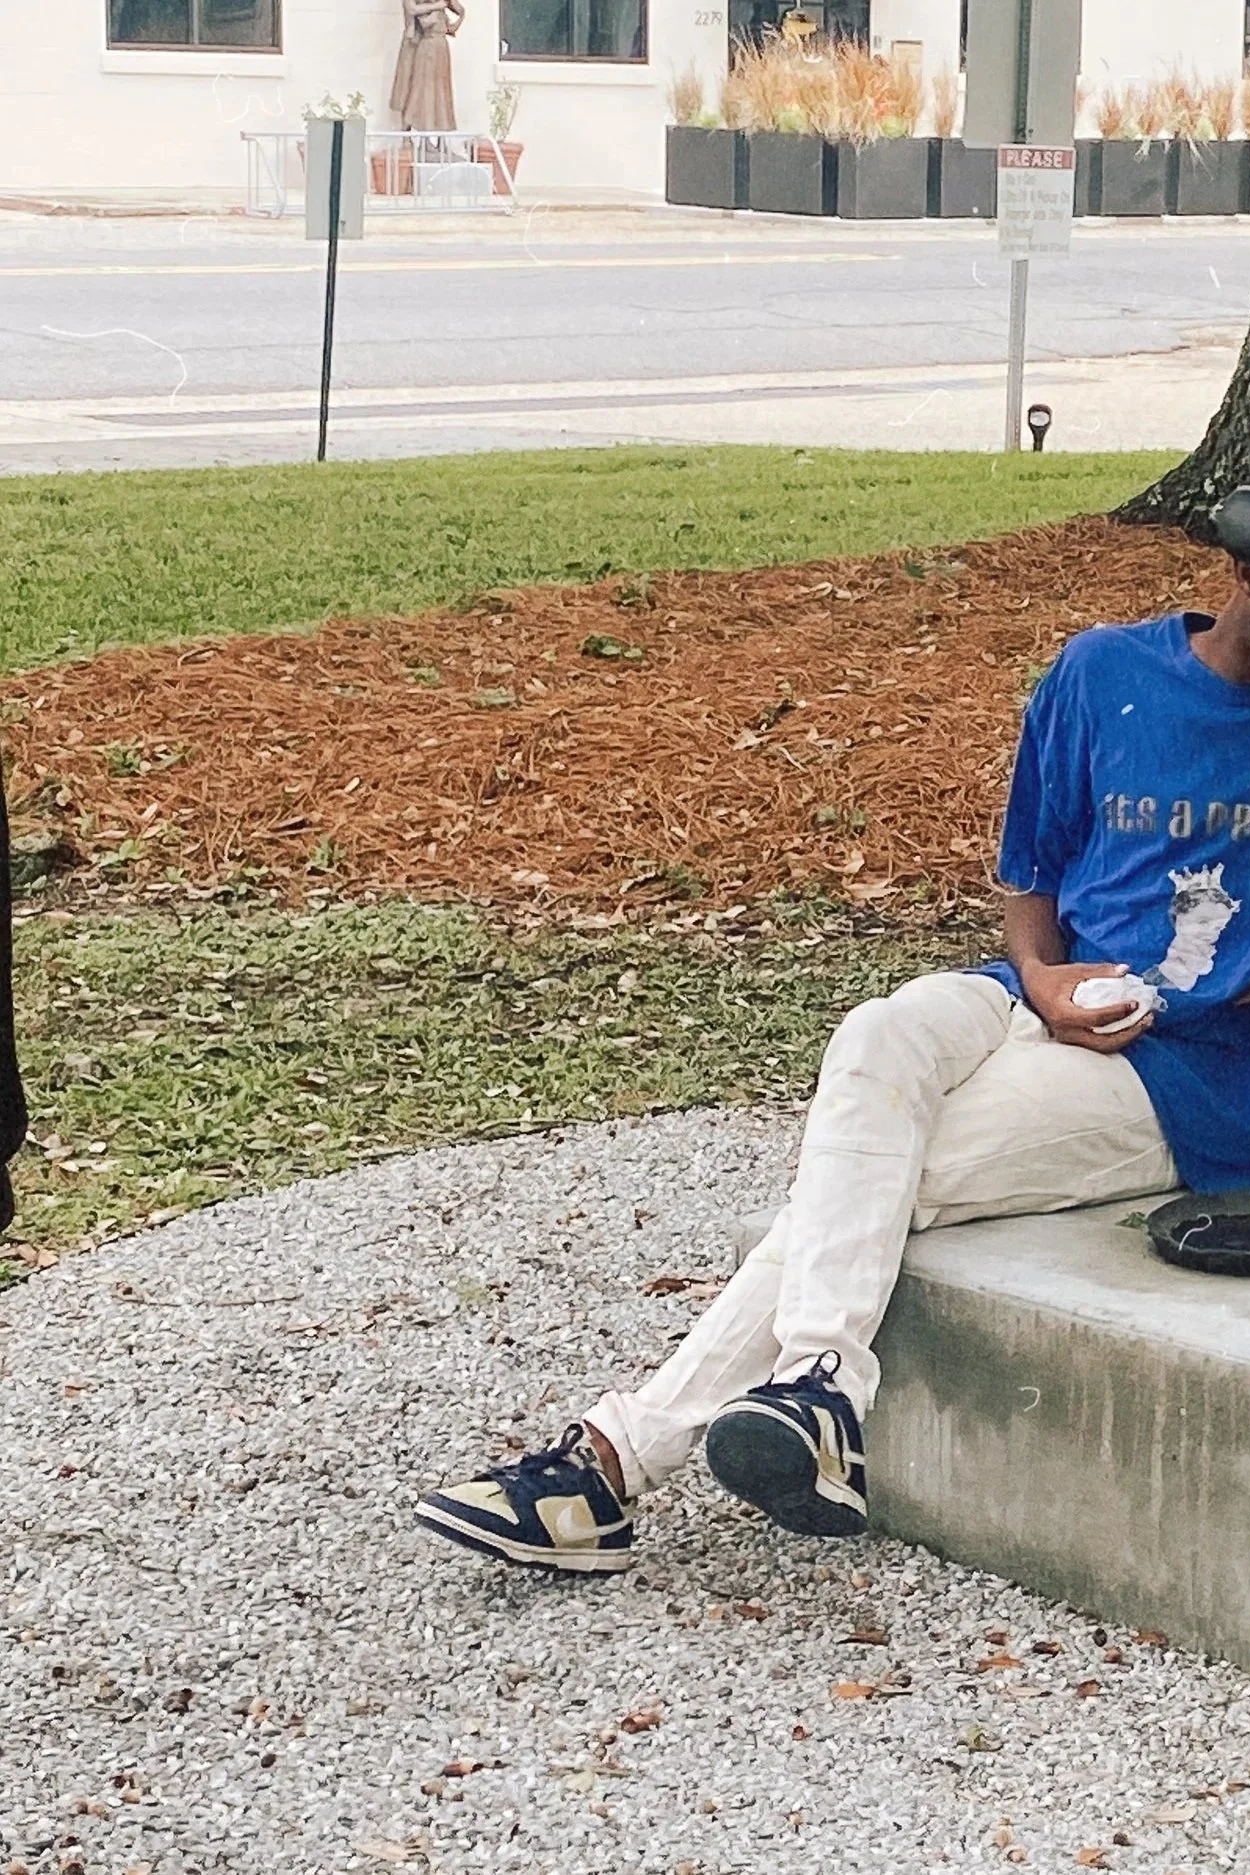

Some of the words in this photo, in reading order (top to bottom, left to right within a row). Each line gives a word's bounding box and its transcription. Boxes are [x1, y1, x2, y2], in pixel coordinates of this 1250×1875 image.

[694, 10, 723, 26] 2279
[1005, 149, 1064, 169] PLEASE
[1104, 792, 1157, 832] its
[1168, 799, 1192, 839] a
